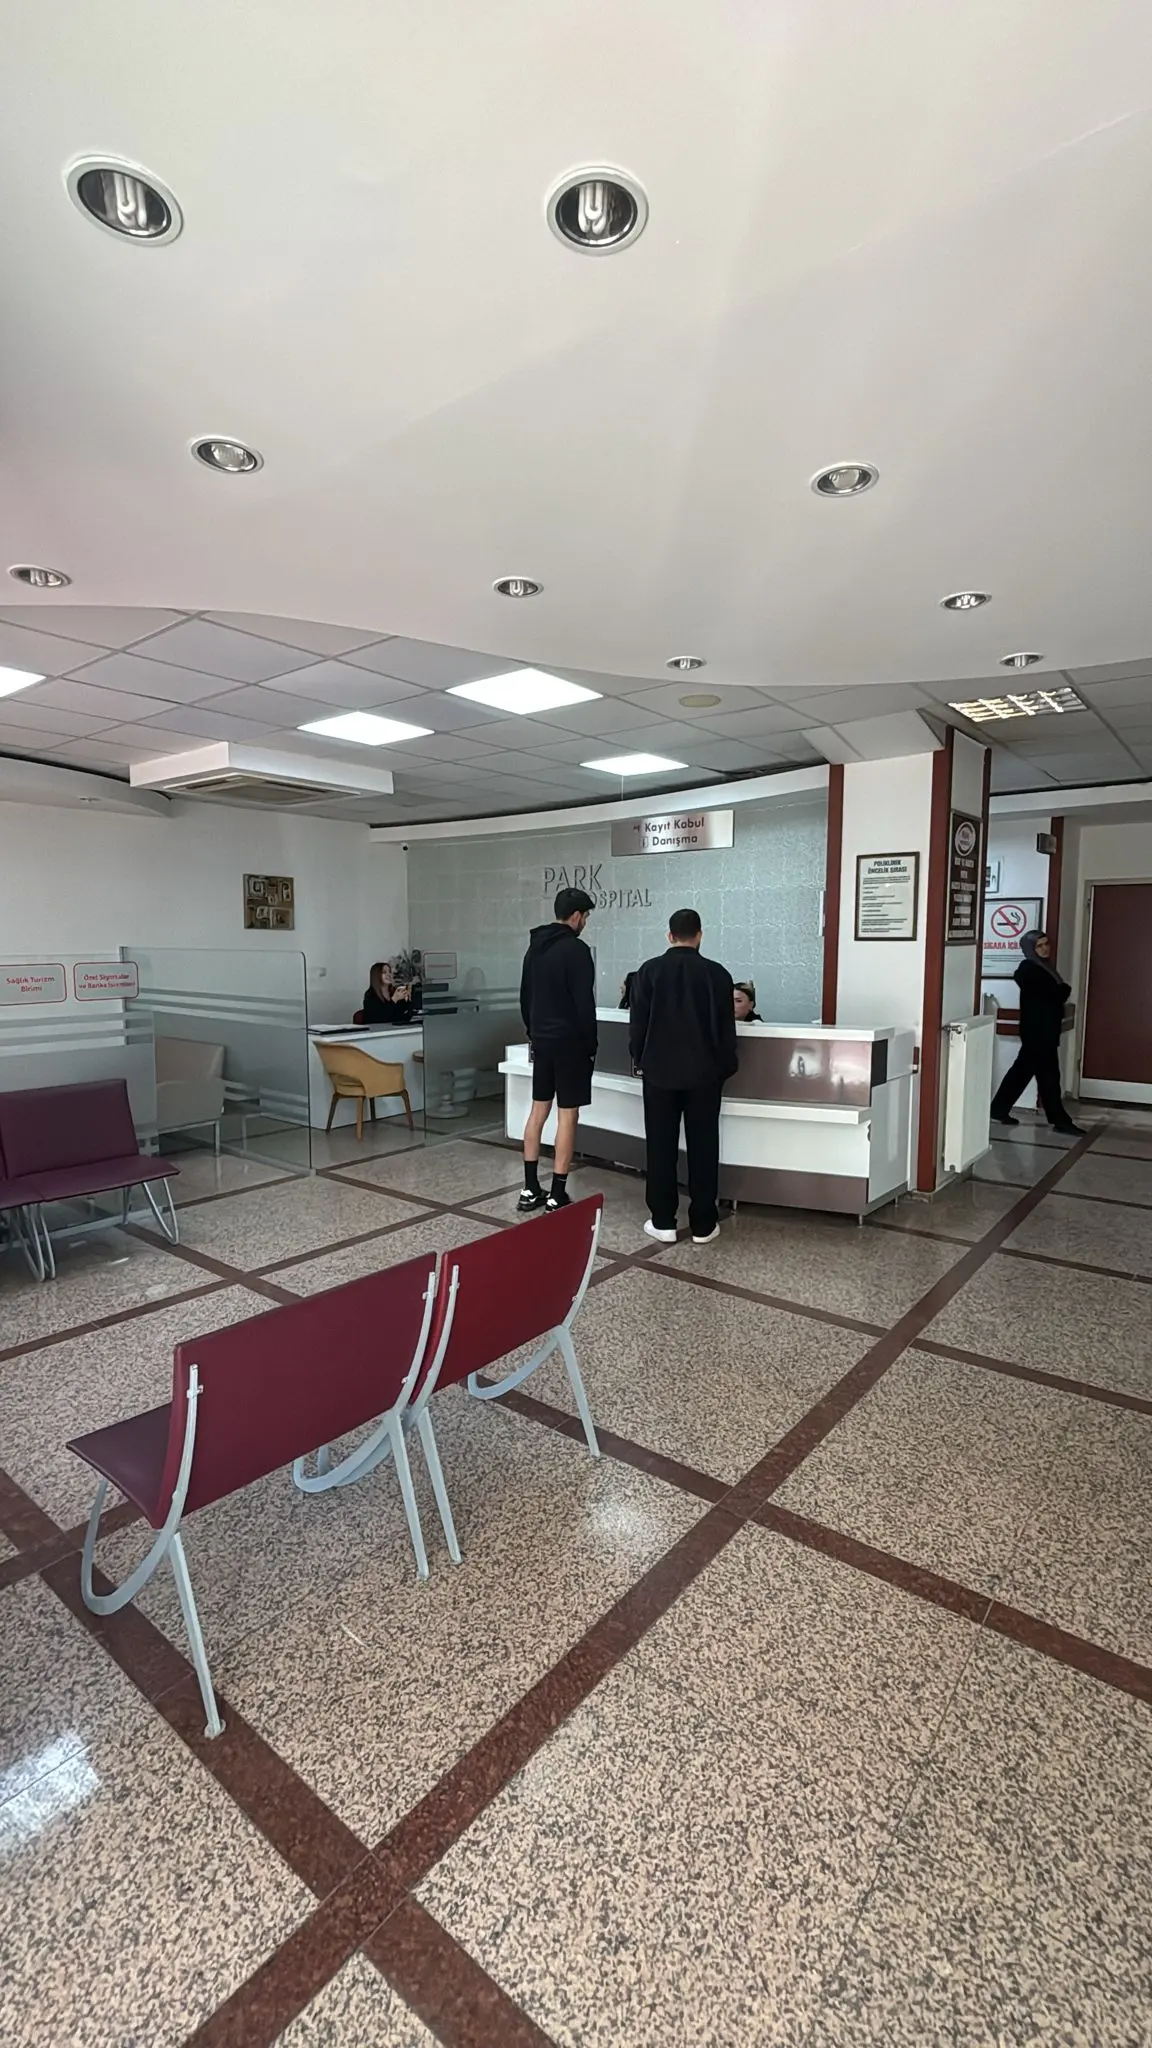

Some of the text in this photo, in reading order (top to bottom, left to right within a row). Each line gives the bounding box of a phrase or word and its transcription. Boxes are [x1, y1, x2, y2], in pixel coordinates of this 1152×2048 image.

[645, 817, 705, 833] Kayıt Kabul
[652, 835, 698, 847] Danışma
[543, 864, 603, 893] PARK
[589, 888, 652, 909] OSPITAL
